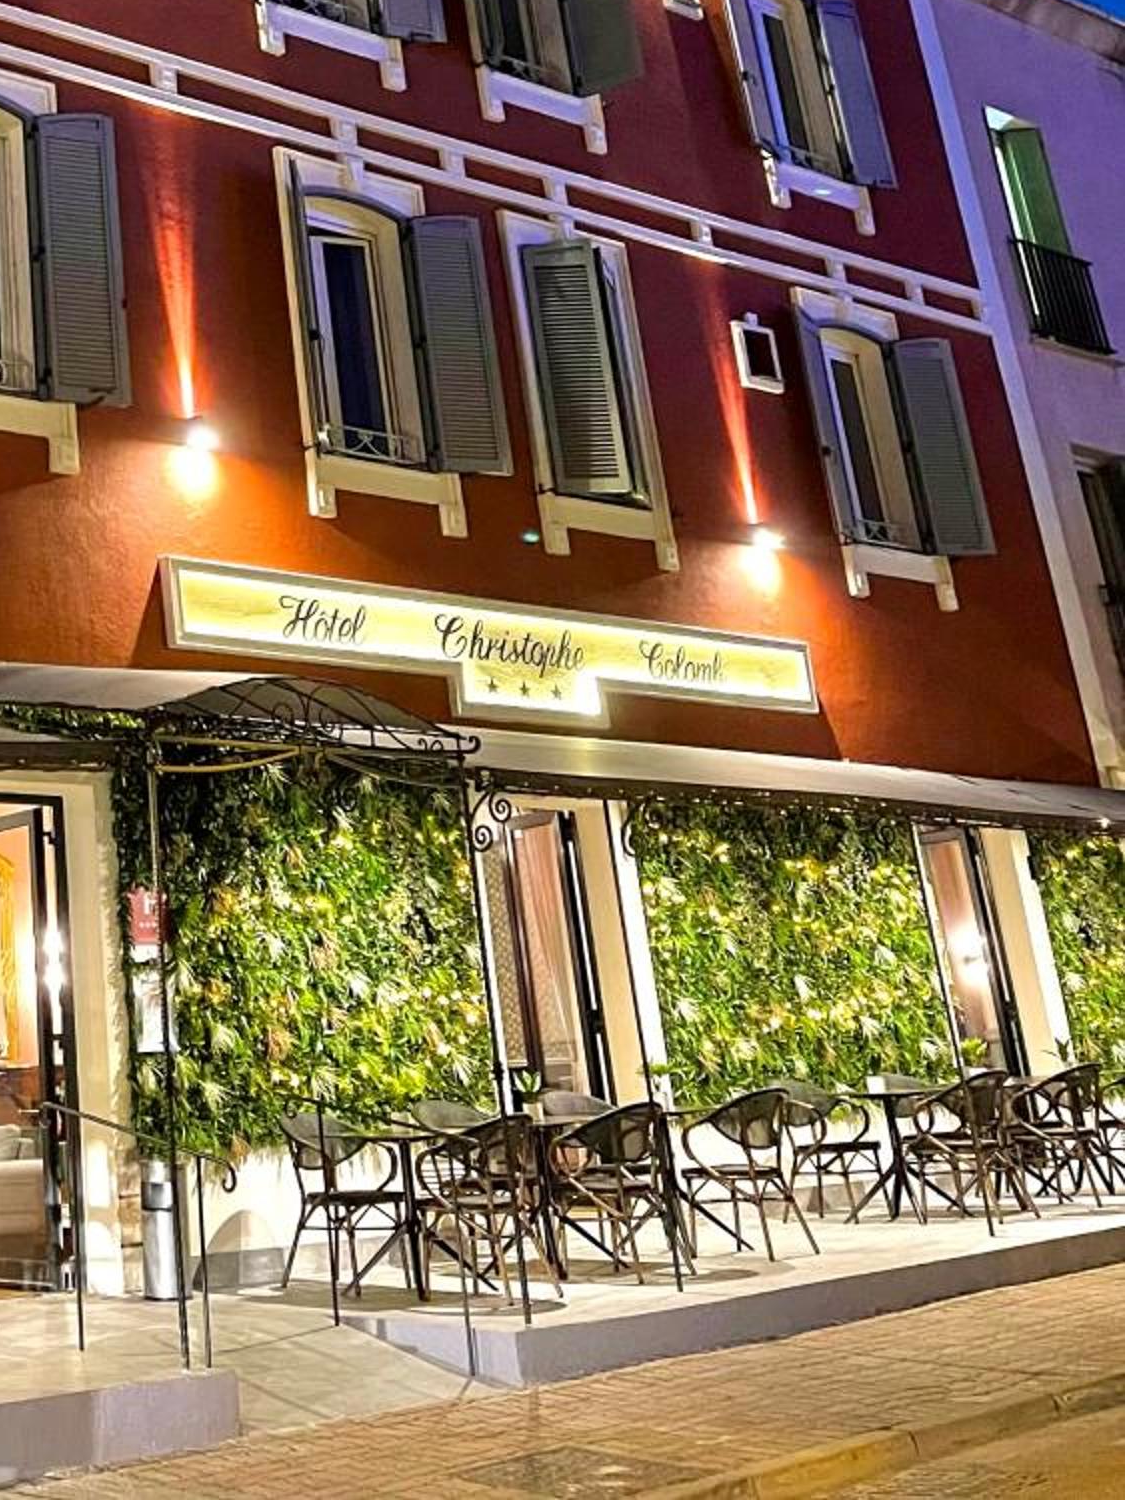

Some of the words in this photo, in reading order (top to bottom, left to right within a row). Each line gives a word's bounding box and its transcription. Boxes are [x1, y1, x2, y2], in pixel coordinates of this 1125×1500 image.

[280, 594, 367, 646] Hôtel
[434, 614, 586, 675] Christophe
[640, 639, 726, 683] Colomb
